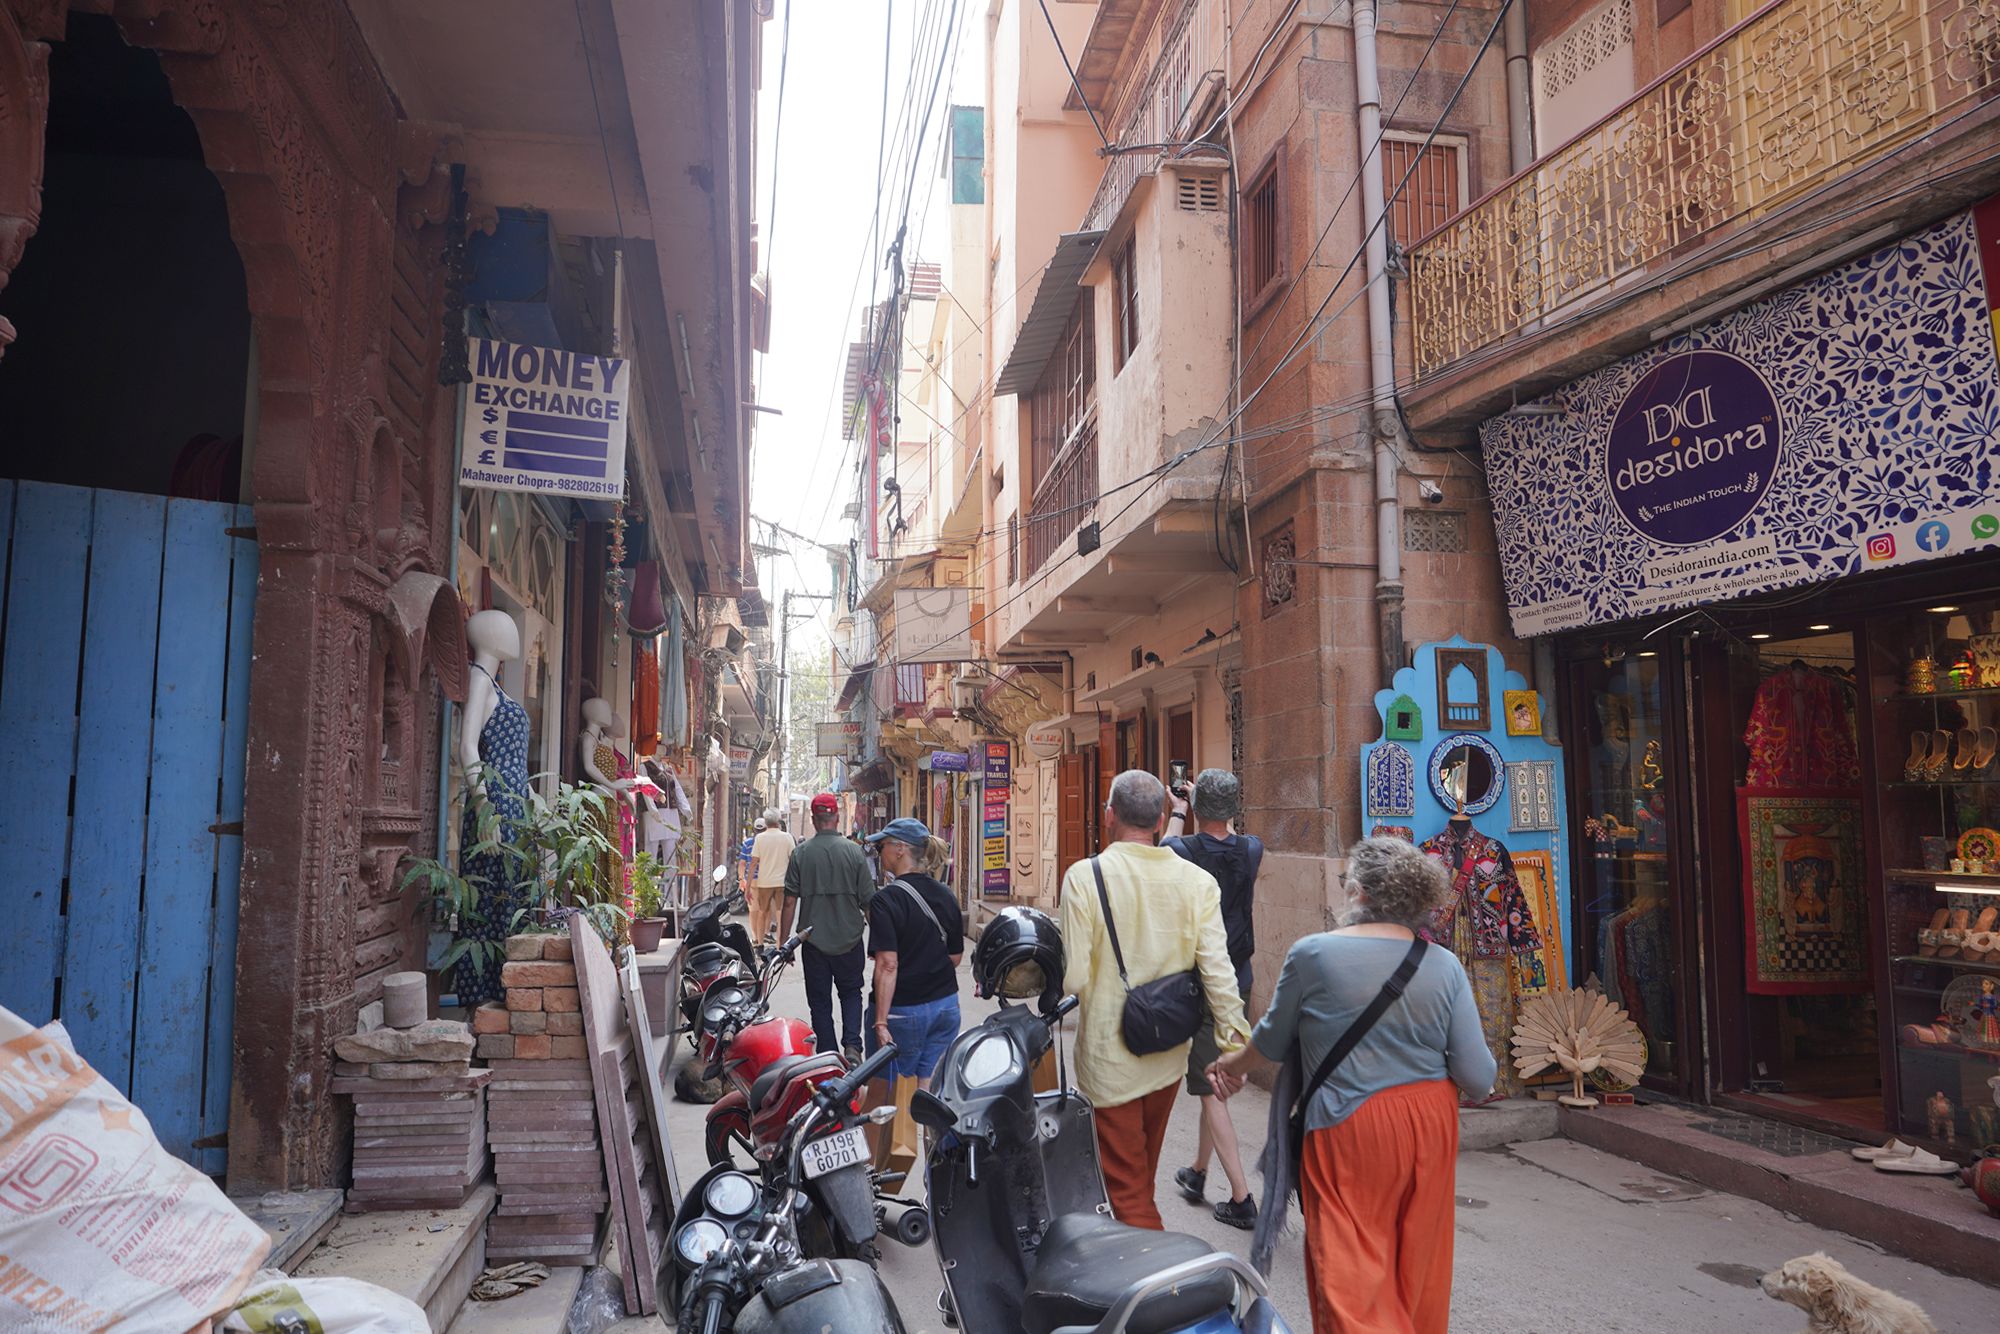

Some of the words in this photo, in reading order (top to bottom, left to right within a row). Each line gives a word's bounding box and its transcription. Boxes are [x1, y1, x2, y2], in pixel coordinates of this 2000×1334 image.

[477, 340, 623, 394] MONEY
[475, 383, 620, 420] EXCHANGE
[482, 407, 499, 424] $
[480, 430, 498, 445] €
[477, 450, 496, 466] £
[1616, 423, 1768, 491] desidora
[462, 468, 514, 485] Mahaveer
[517, 474, 619, 495] Chopra-9828026191
[1650, 545, 1770, 579] Desidoraindia.com
[1658, 585, 1712, 602] manufacturer
[1723, 574, 1778, 590] wholesalers
[1780, 569, 1800, 579] also
[1516, 608, 1541, 620] Contact:
[816, 1147, 859, 1173] G0701
